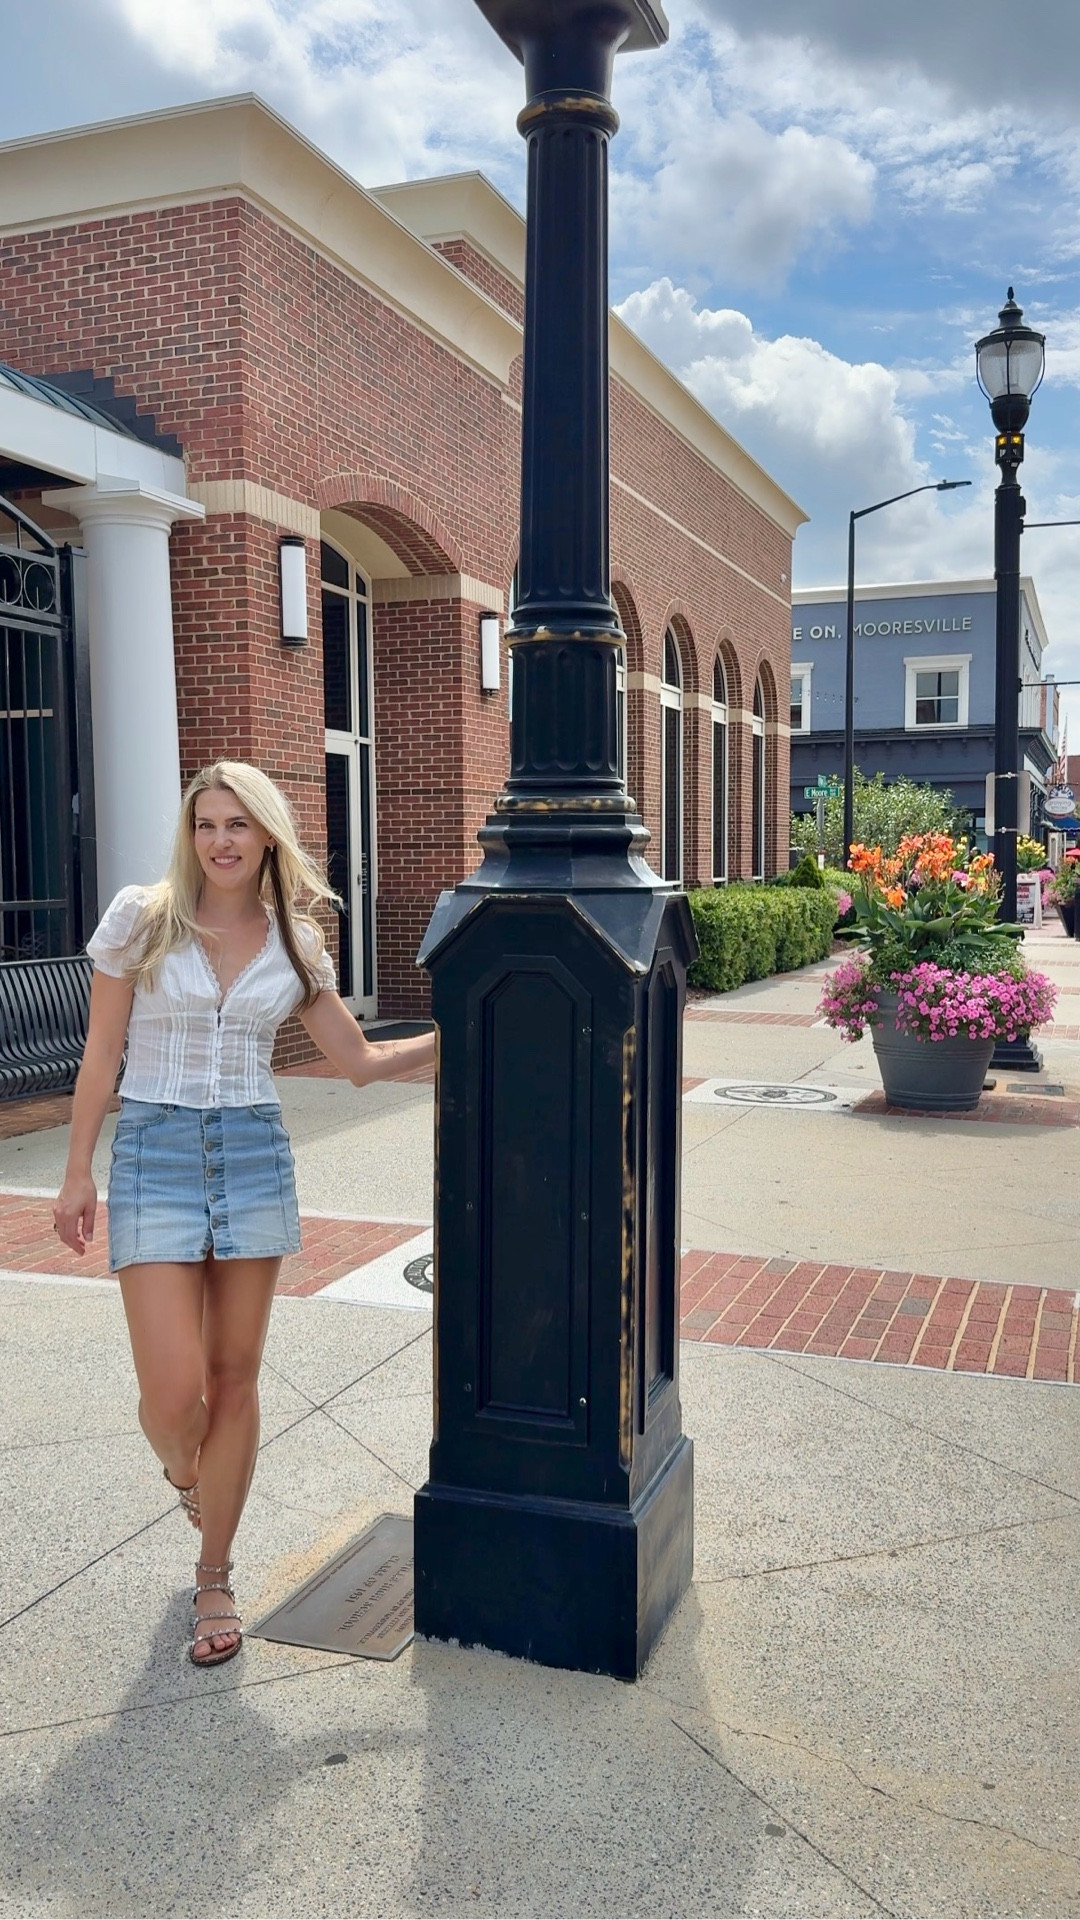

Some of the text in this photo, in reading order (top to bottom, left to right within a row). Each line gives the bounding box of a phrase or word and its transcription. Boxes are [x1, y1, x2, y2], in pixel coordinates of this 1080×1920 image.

[793, 617, 972, 640] E ON, MOORESVILLE
[811, 789, 828, 797] Moore
[375, 1555, 399, 1577] CLASS
[364, 1576, 376, 1587] OF
[369, 1582, 394, 1601] HIGH
[338, 1601, 374, 1632] SCHOOL
